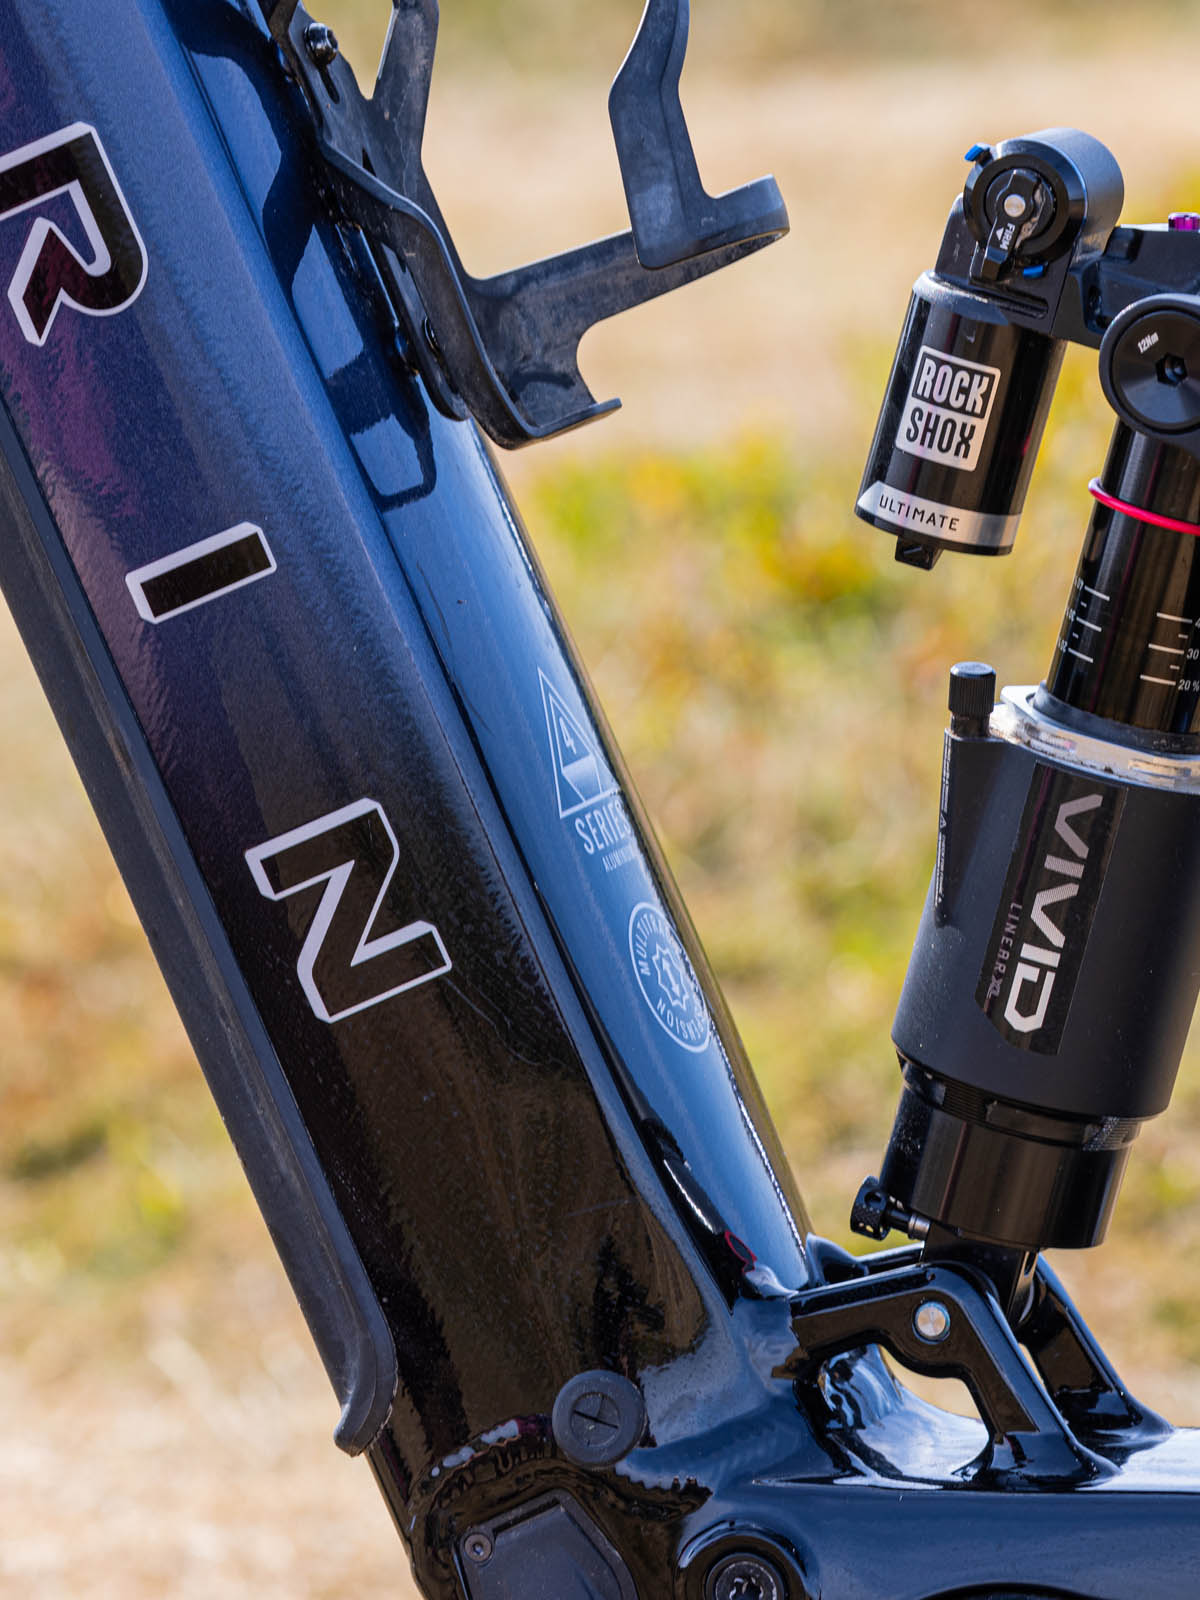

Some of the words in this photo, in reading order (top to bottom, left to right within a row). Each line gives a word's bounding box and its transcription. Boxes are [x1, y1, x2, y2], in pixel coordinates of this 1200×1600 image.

[1000, 222, 1015, 250] FIRM
[916, 357, 990, 415] ROCK
[906, 407, 976, 459] SHOX
[879, 493, 960, 531] ULTIMATE
[559, 716, 577, 755] 4
[574, 799, 633, 855] SERIES
[993, 902, 1023, 975] LINEAR
[1004, 793, 1104, 1033] VIVID
